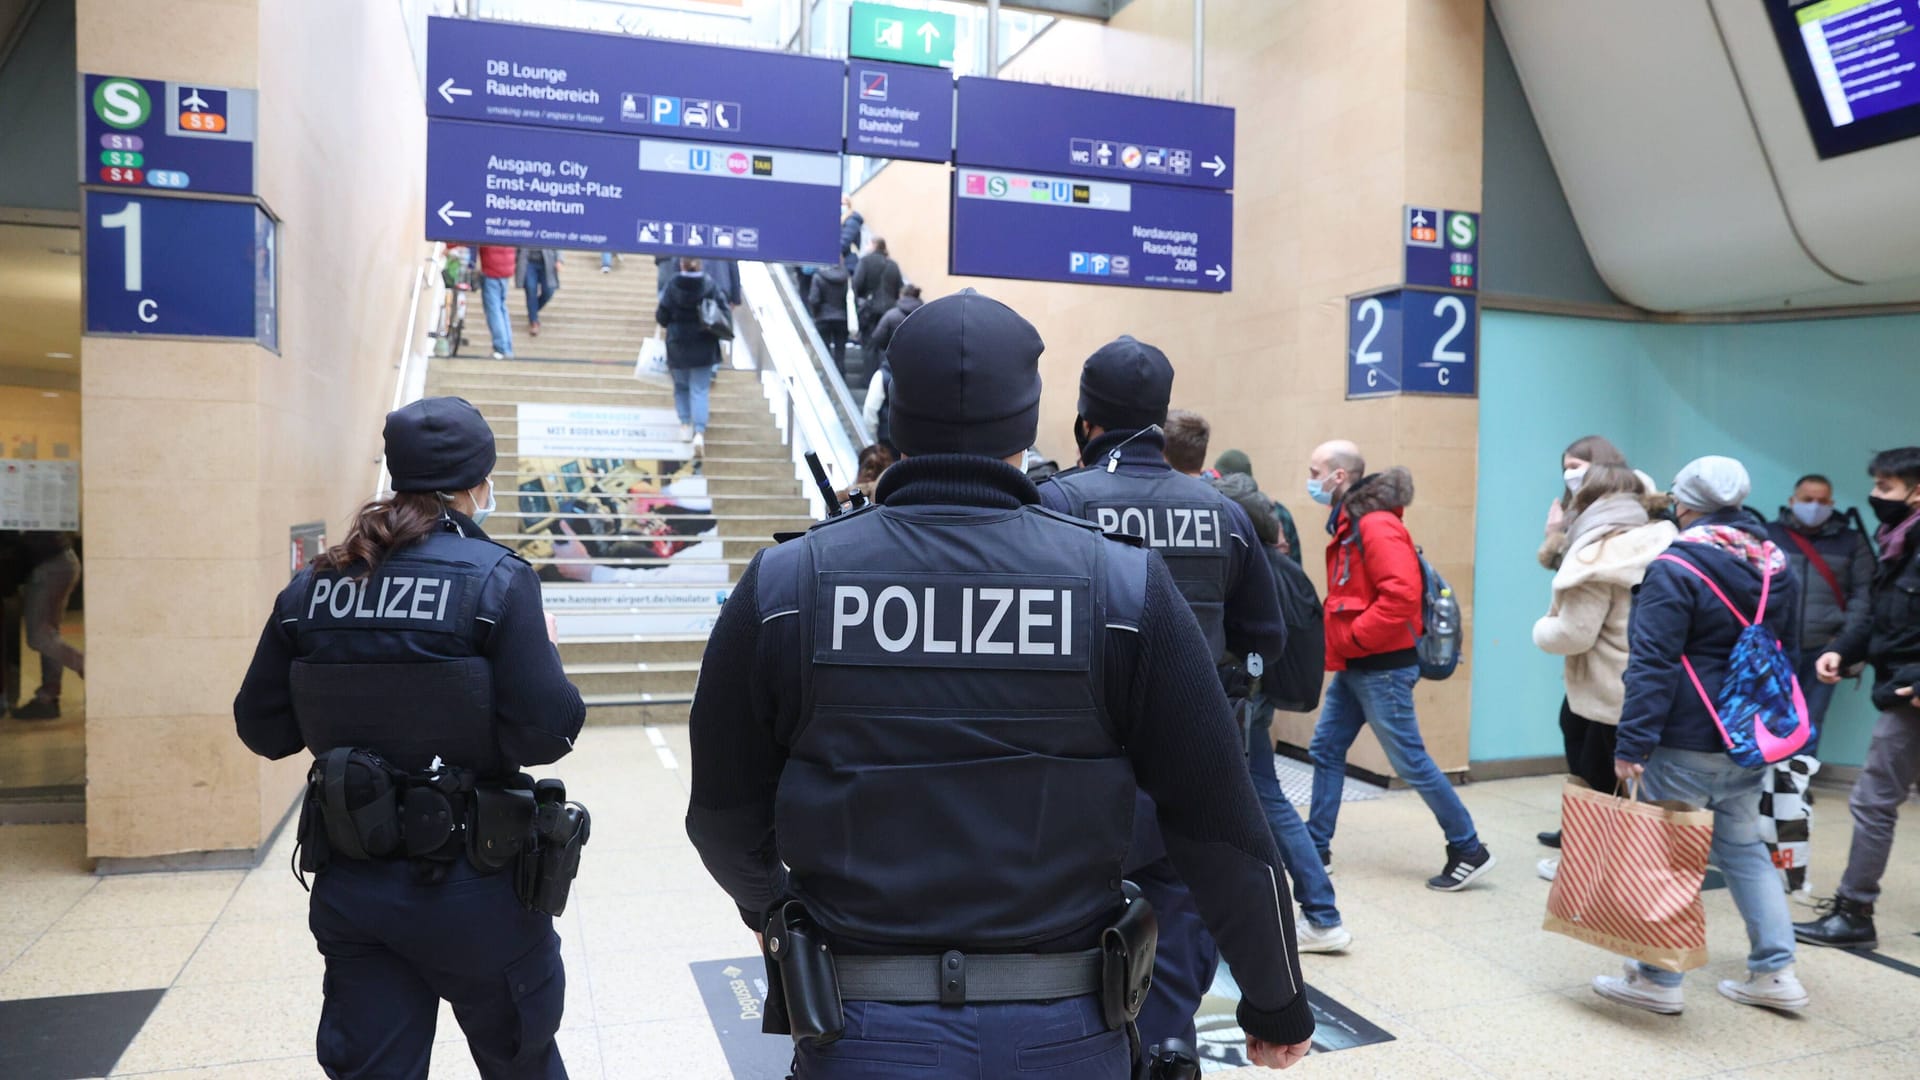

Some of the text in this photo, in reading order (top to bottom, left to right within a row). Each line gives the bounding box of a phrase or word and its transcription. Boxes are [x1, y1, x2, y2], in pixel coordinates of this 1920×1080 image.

[486, 59, 567, 84] DB Lounge
[103, 82, 142, 124] S
[486, 79, 600, 105] Raucherbereich
[858, 102, 920, 121] Rauchfreier
[858, 117, 904, 134] Bahnhof
[487, 155, 588, 179] Ausgang, City
[1071, 150, 1089, 163] WC
[486, 174, 623, 199] Ernst-August-Platz
[486, 193, 585, 215] Reisezentrum
[1132, 225, 1198, 245] Nordausgang
[1451, 214, 1473, 245] S
[101, 202, 142, 291] 1
[1142, 241, 1198, 258] Raschplatz
[1174, 257, 1198, 273] ZOB
[138, 299, 158, 323] C
[1355, 298, 1384, 365] 2
[1432, 295, 1466, 363] 2
[1097, 507, 1221, 548] POLIZEI
[307, 576, 452, 621] POLIZEI
[832, 585, 1072, 656] POLIZEI
[729, 979, 761, 1020] Degussa
